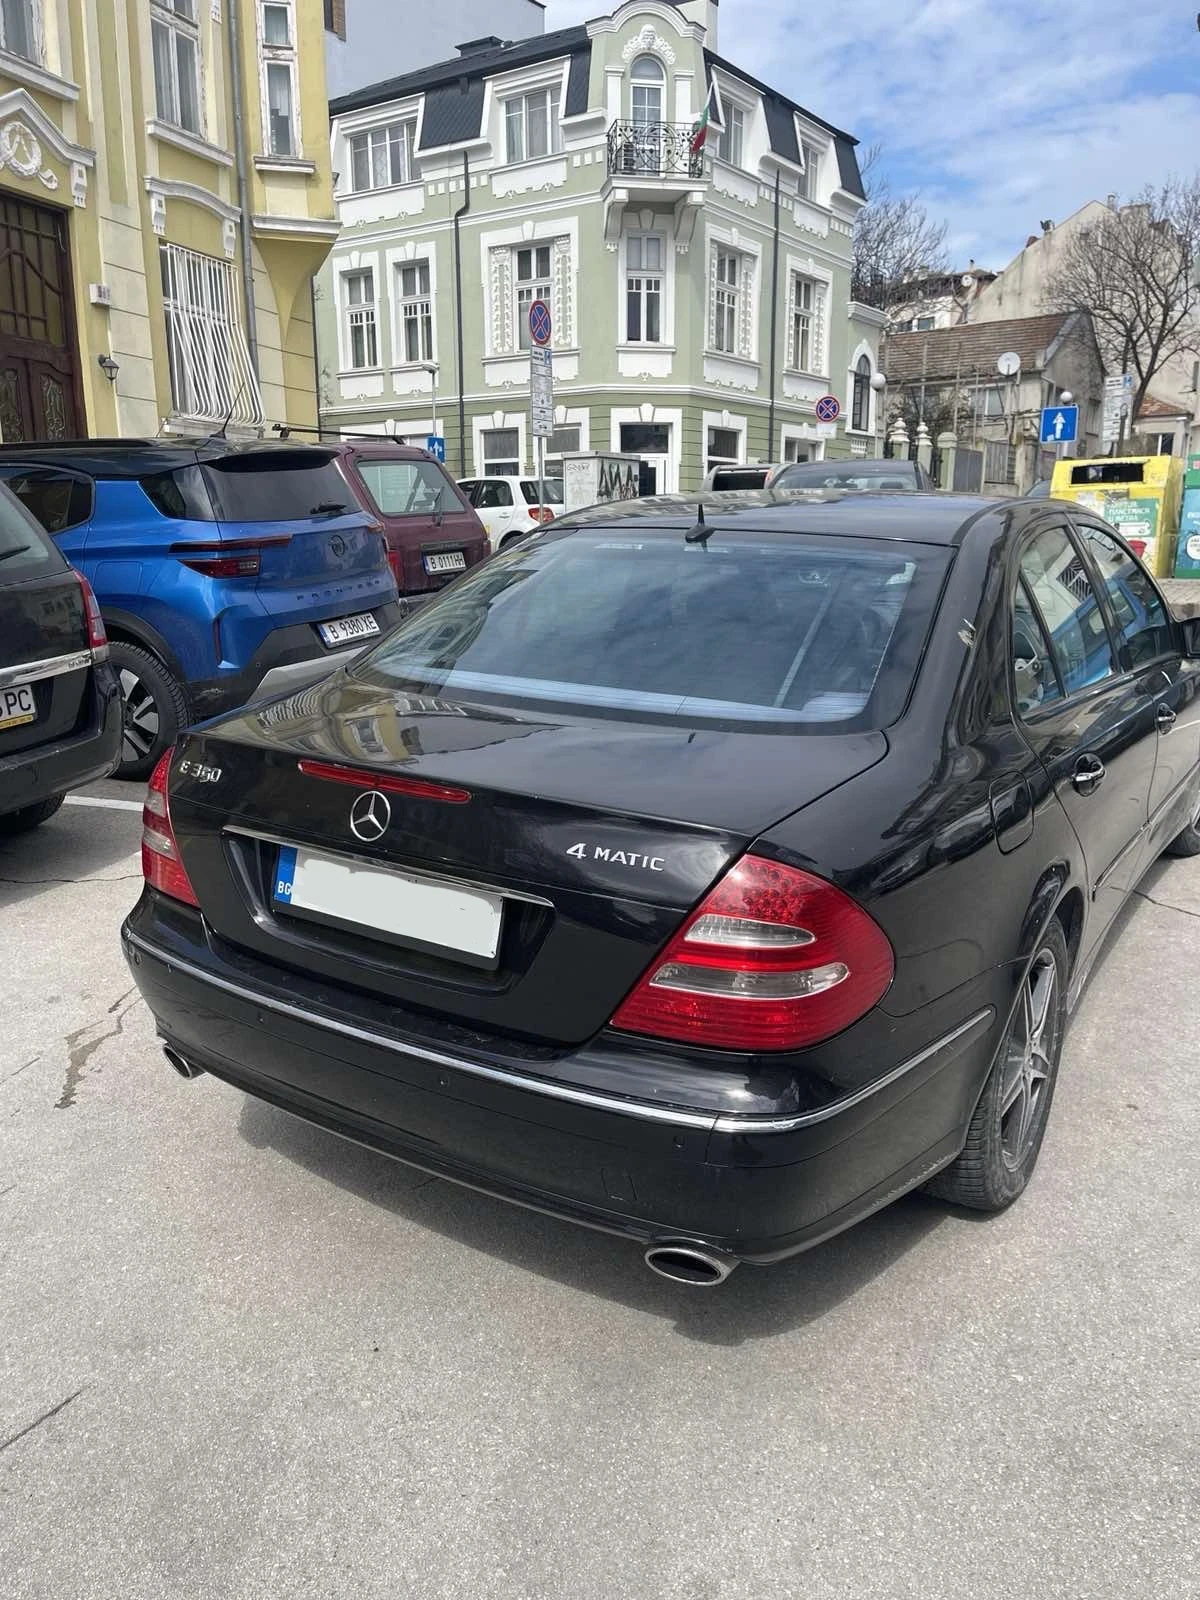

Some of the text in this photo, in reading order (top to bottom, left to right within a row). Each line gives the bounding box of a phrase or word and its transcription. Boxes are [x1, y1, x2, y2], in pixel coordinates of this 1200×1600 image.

[328, 624, 339, 640] B
[180, 760, 222, 783] E 350
[566, 843, 665, 871] 4 MATIC
[278, 880, 292, 896] BG
